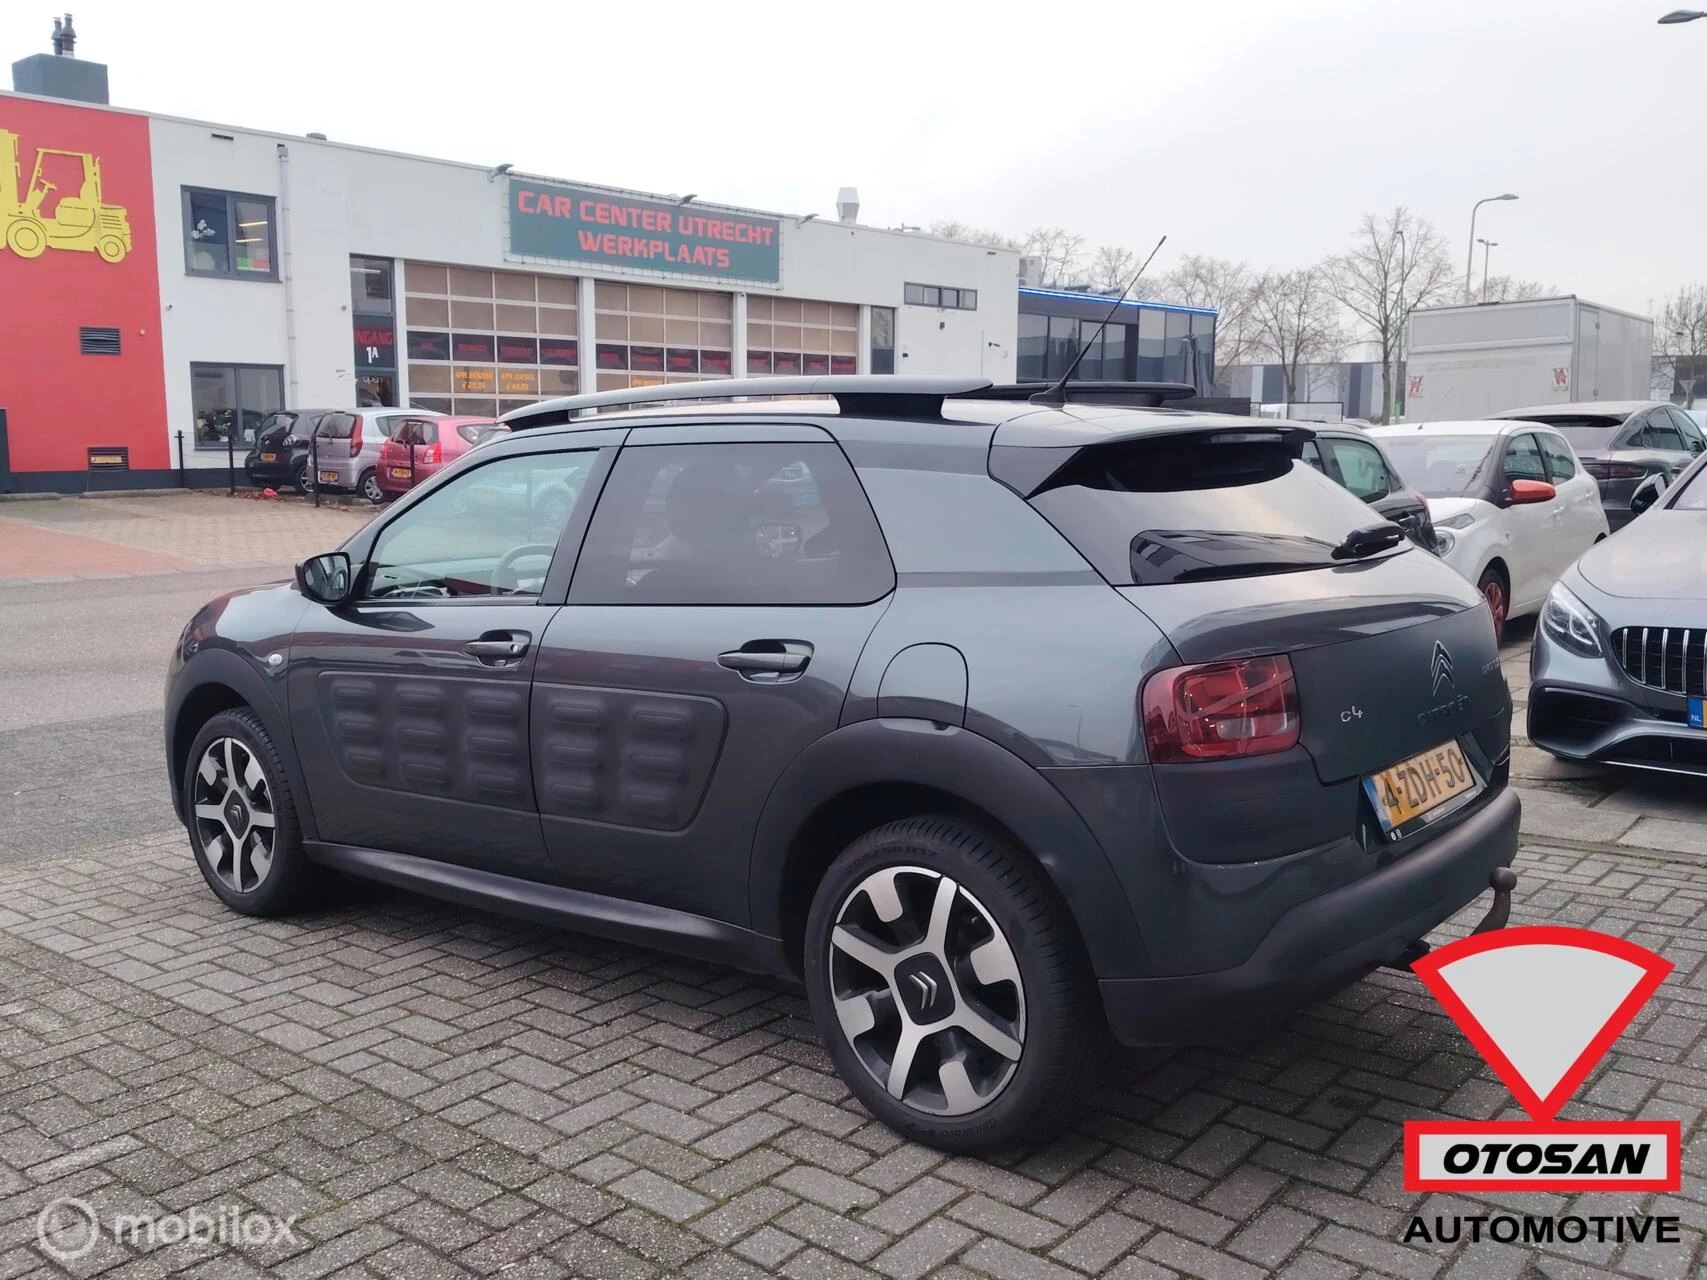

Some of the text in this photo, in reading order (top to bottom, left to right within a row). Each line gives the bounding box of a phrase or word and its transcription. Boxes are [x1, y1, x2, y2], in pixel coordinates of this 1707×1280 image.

[517, 190, 773, 246] CAR CENTER UTRECHT
[577, 230, 730, 269] WERKPLAATS
[366, 346, 379, 364] 1A
[1691, 714, 1701, 722] NL
[1383, 747, 1466, 815] 4-ZDH-50
